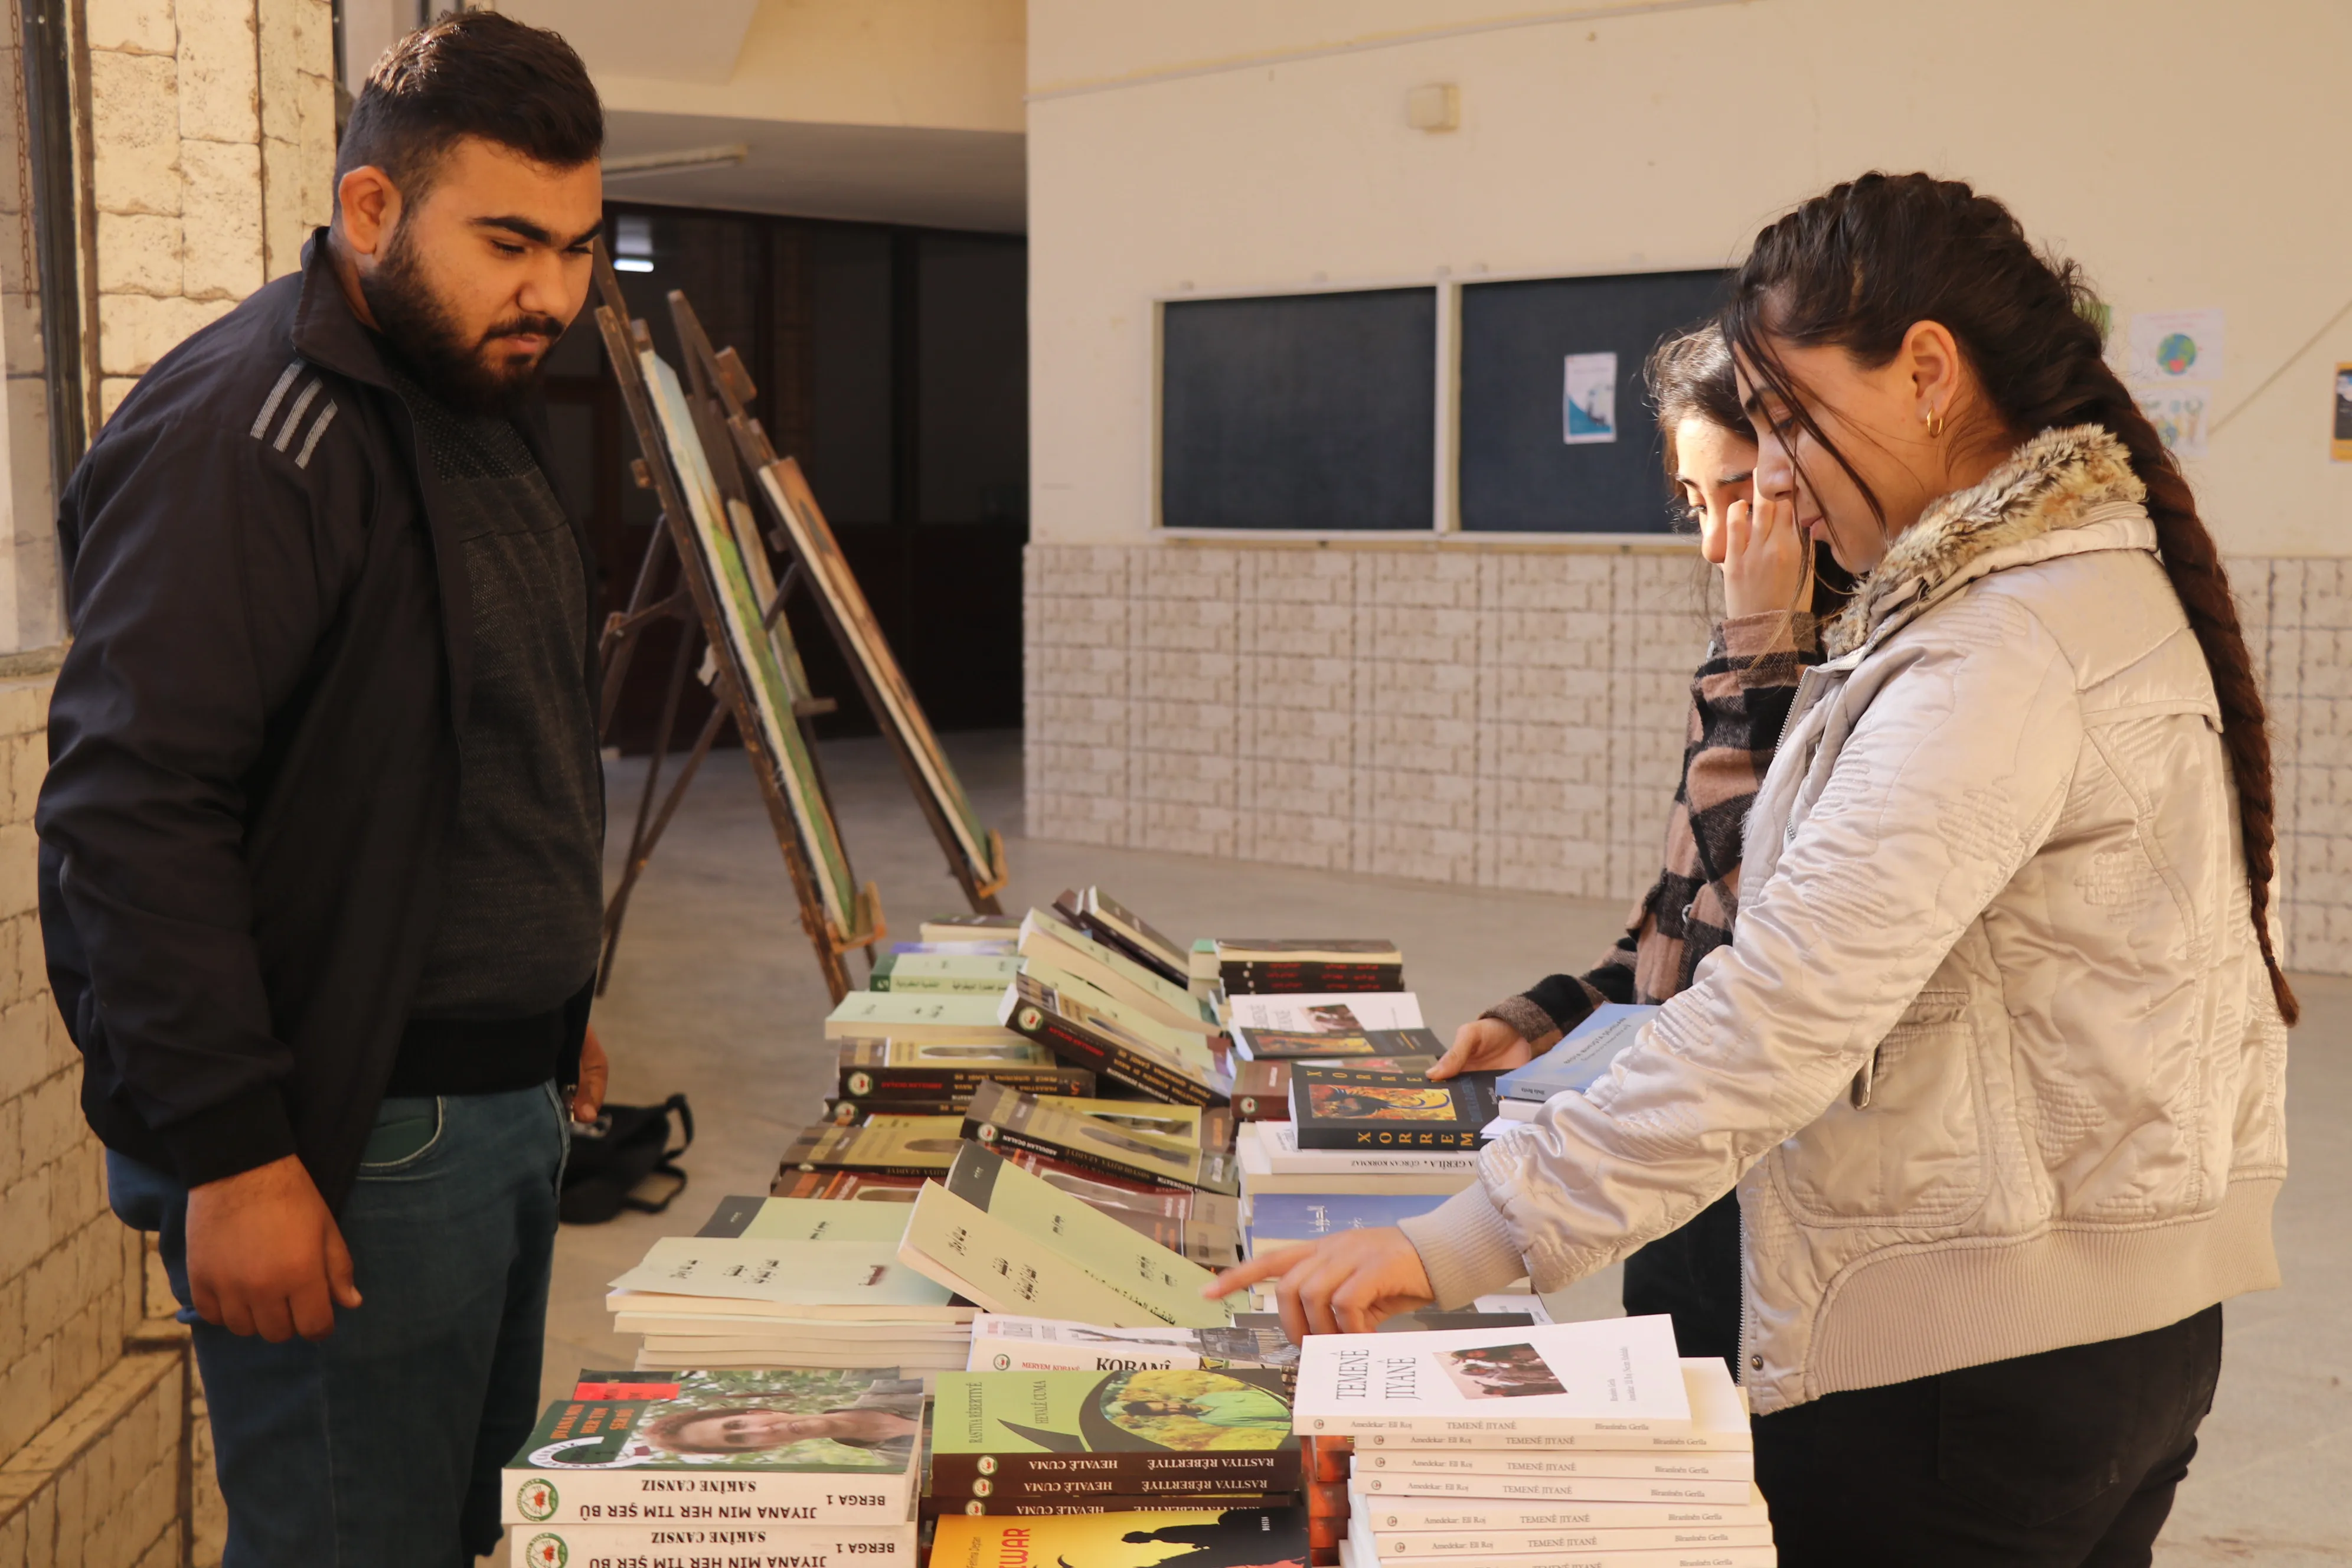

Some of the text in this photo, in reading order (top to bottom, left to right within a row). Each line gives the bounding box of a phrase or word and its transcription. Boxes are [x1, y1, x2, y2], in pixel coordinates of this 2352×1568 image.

[1329, 1350, 1369, 1400] TEMENÊ
[1377, 1357, 1422, 1400] JIYANÊ
[1033, 1380, 1047, 1400] CUMA
[1029, 1458, 1274, 1471] RASTIYA RÊBERTIYÊ HEVALÊ CUMA
[642, 1479, 695, 1491] CANSIZ
[1024, 1480, 1268, 1493] RASTIYA RÊBERTIYÊ HEVALÊ CUMA
[826, 1495, 886, 1505] BERGA 1
[580, 1502, 818, 1521] JIYANA MIN HER TIM ŞER BÛ
[1017, 1506, 1053, 1515] CUMA
[651, 1531, 705, 1543] CANSIZ
[836, 1543, 895, 1554] BERGA 1
[617, 1555, 648, 1568] ŞER
[654, 1558, 685, 1568] TIM
[690, 1557, 722, 1568] HER
[729, 1557, 760, 1568] MIN
[767, 1556, 827, 1568] JIYANA
